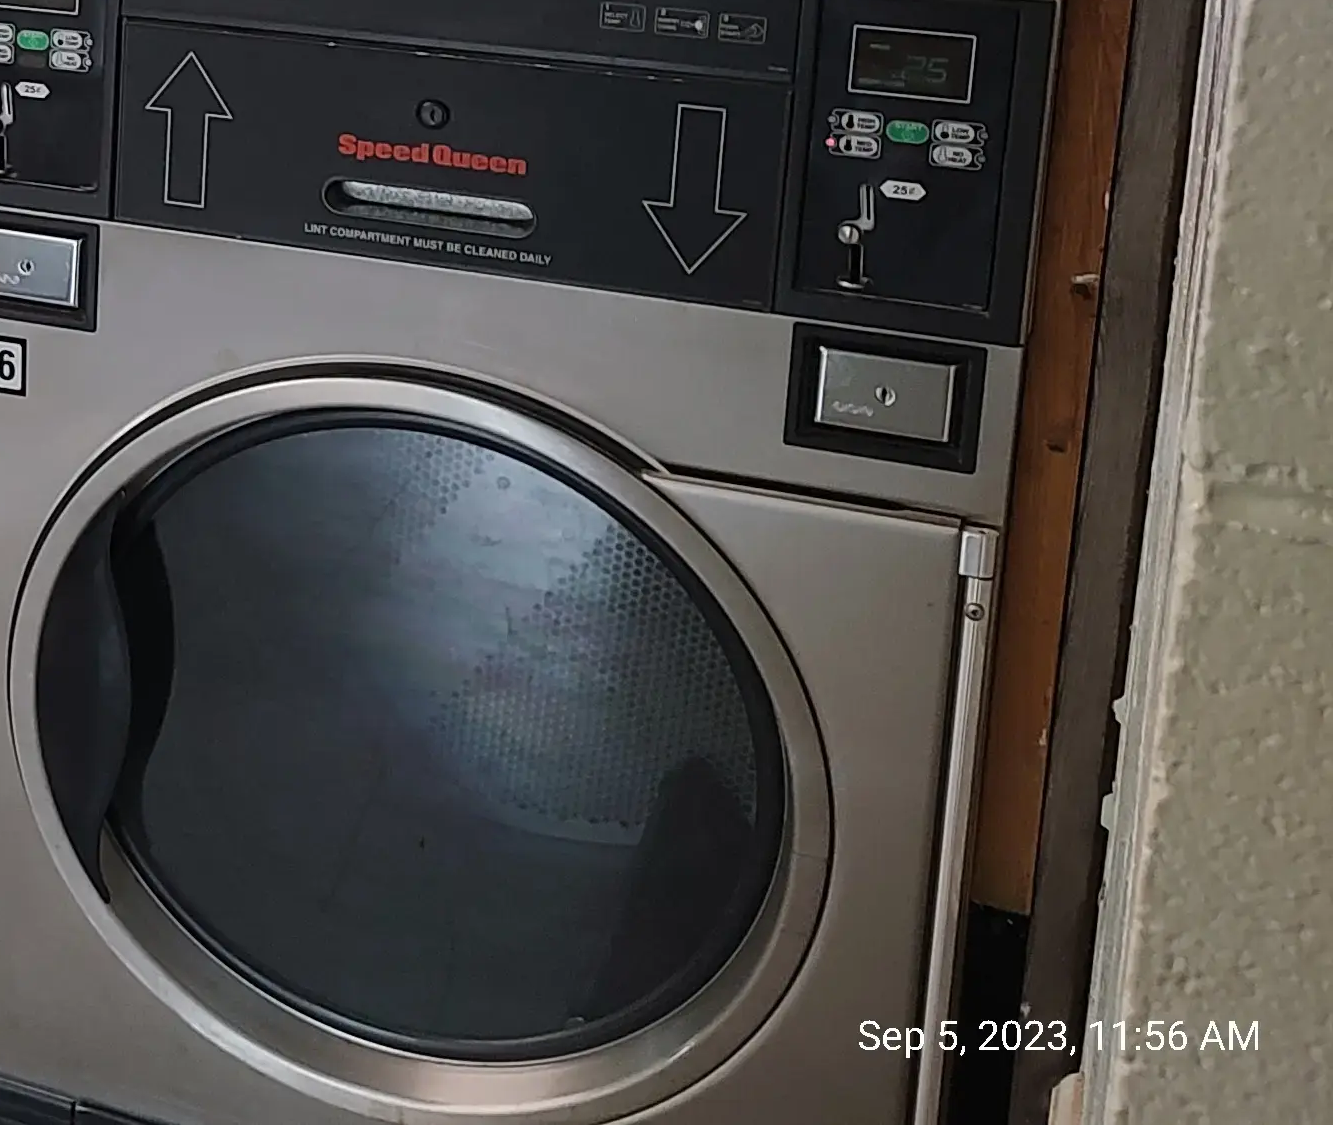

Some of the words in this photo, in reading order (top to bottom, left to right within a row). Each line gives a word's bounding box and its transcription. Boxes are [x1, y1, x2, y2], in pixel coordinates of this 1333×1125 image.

[338, 133, 429, 164] Speed
[432, 144, 527, 175] Queen
[304, 222, 328, 235] LINT
[329, 226, 412, 247] COMPARTMENT
[413, 236, 443, 251] MUST
[446, 242, 461, 254] BE
[464, 244, 517, 261] CLEANED
[519, 251, 552, 266] DAILY
